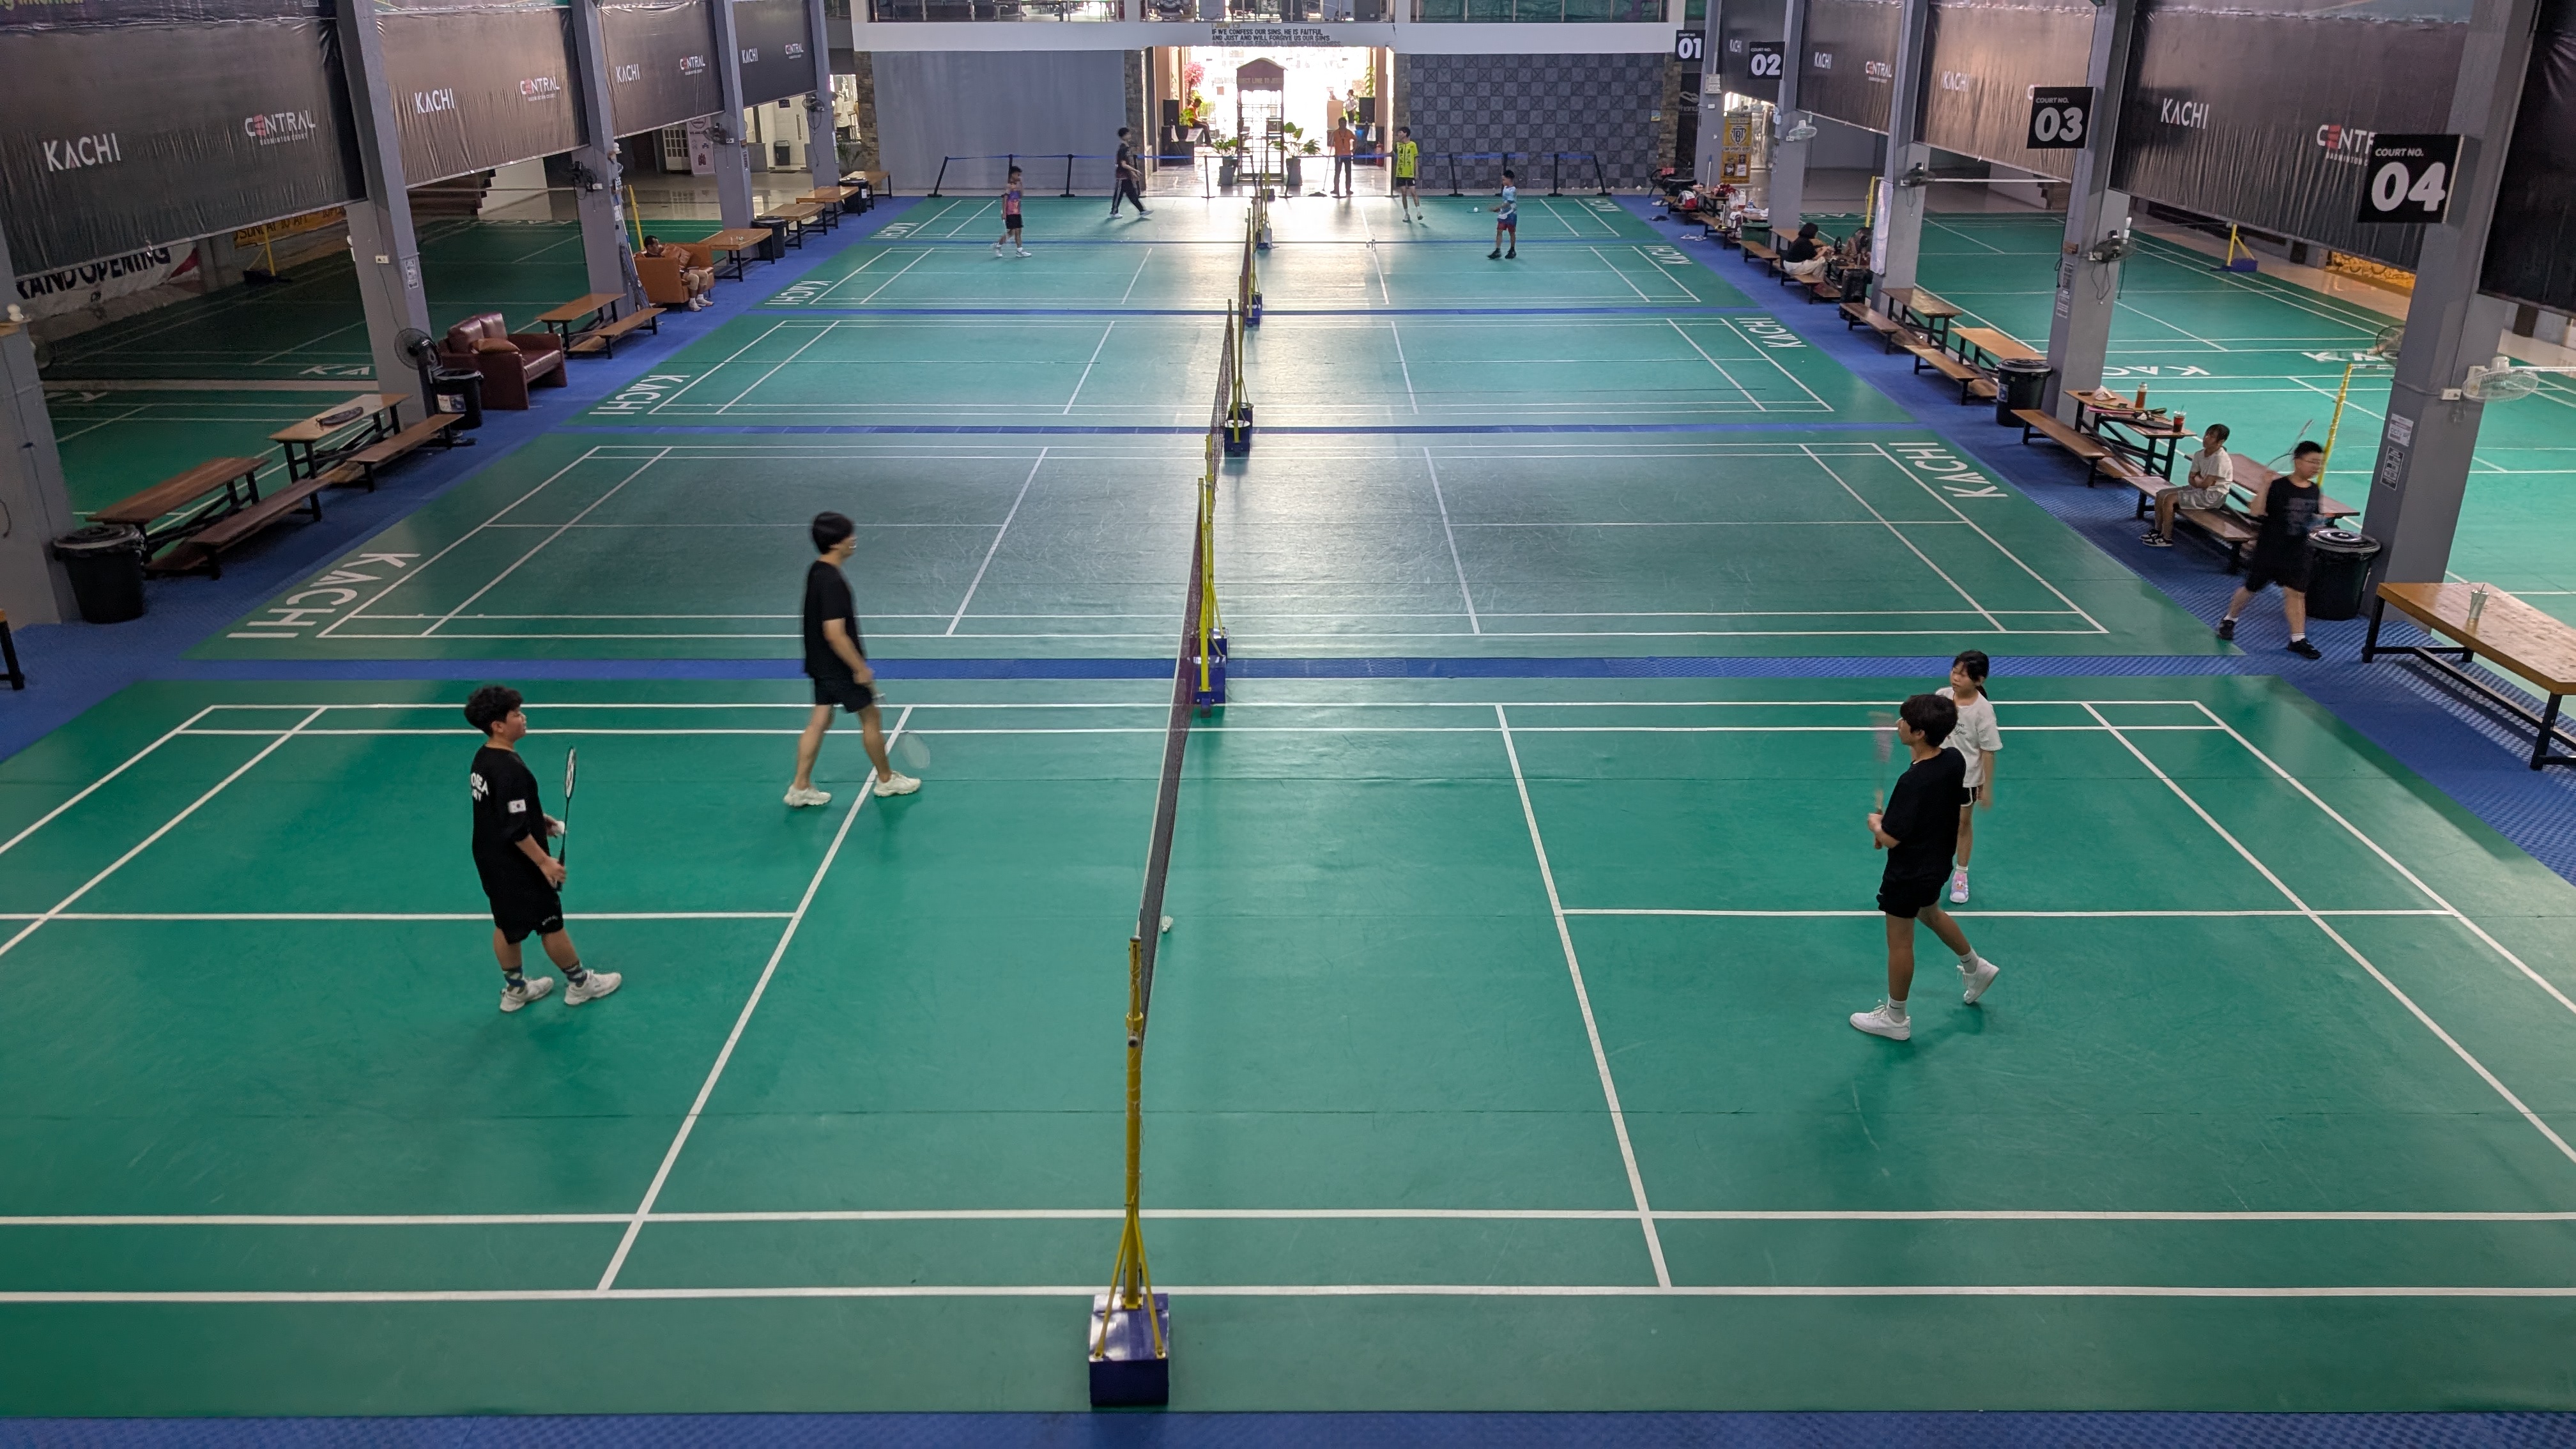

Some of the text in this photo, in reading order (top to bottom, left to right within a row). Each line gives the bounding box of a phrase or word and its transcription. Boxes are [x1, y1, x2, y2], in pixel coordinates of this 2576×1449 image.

[742, 48, 758, 63] KACHI
[1678, 38, 1702, 59] 01
[680, 54, 705, 70] CENTRAL
[1751, 54, 1781, 75] 02
[1814, 52, 1832, 69] KACHI
[1866, 61, 1892, 78] CENTRAL
[615, 64, 640, 82] KACHI
[1943, 70, 1968, 92] KACHI
[520, 77, 560, 95] CENTRAL
[415, 88, 454, 114] KACHI
[245, 110, 316, 136] CENTRAL
[2035, 107, 2083, 141] 03
[2161, 98, 2209, 129] KACHI
[43, 133, 121, 171] KACHI
[2375, 148, 2424, 157] COURT NO.
[2371, 162, 2446, 211] 04
[1584, 199, 1622, 211] KACHI
[870, 222, 919, 239] KACHI
[1643, 246, 1693, 264] KACHI
[765, 280, 832, 305] KACHI
[1735, 318, 1807, 347] KACHI
[591, 375, 691, 414] KACHI
[1888, 442, 2009, 497] KACHI
[226, 553, 421, 638] KACHI
